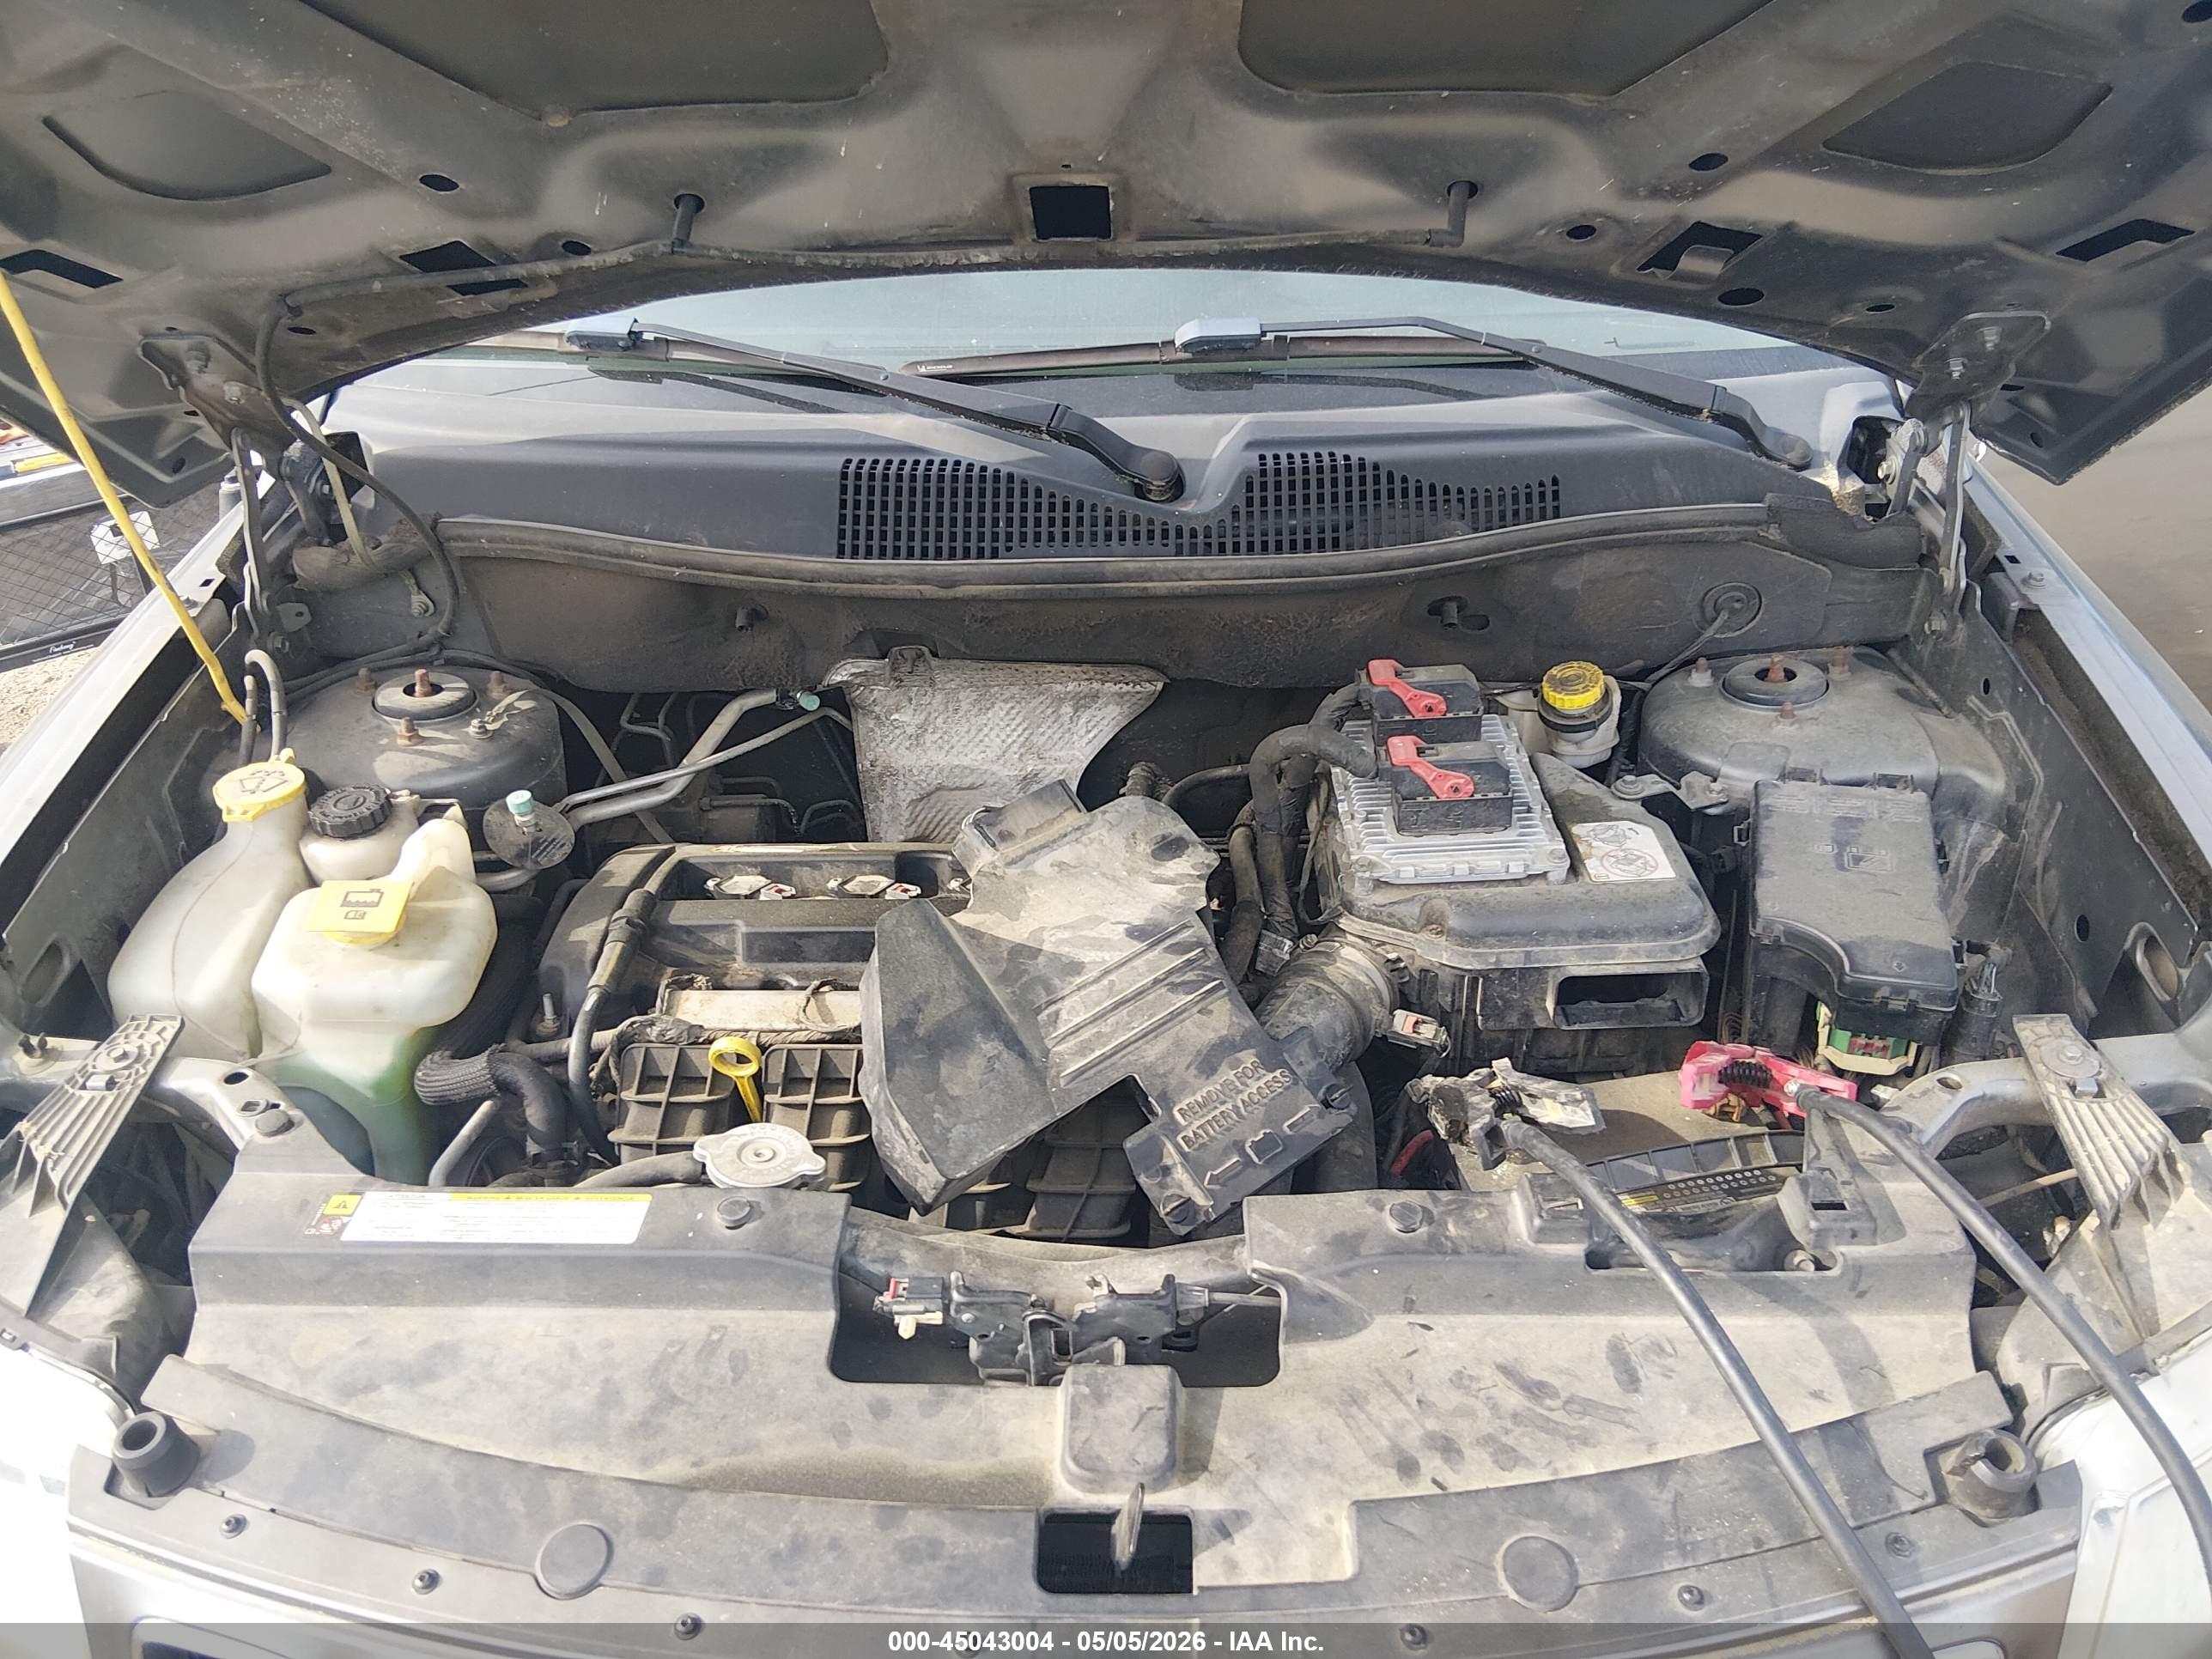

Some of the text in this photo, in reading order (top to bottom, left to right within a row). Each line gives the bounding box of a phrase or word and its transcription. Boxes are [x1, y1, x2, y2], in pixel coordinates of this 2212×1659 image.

[1175, 1059, 1267, 1123] REMOVE FOR
[1179, 1069, 1292, 1151] BATTERY ACCESS
